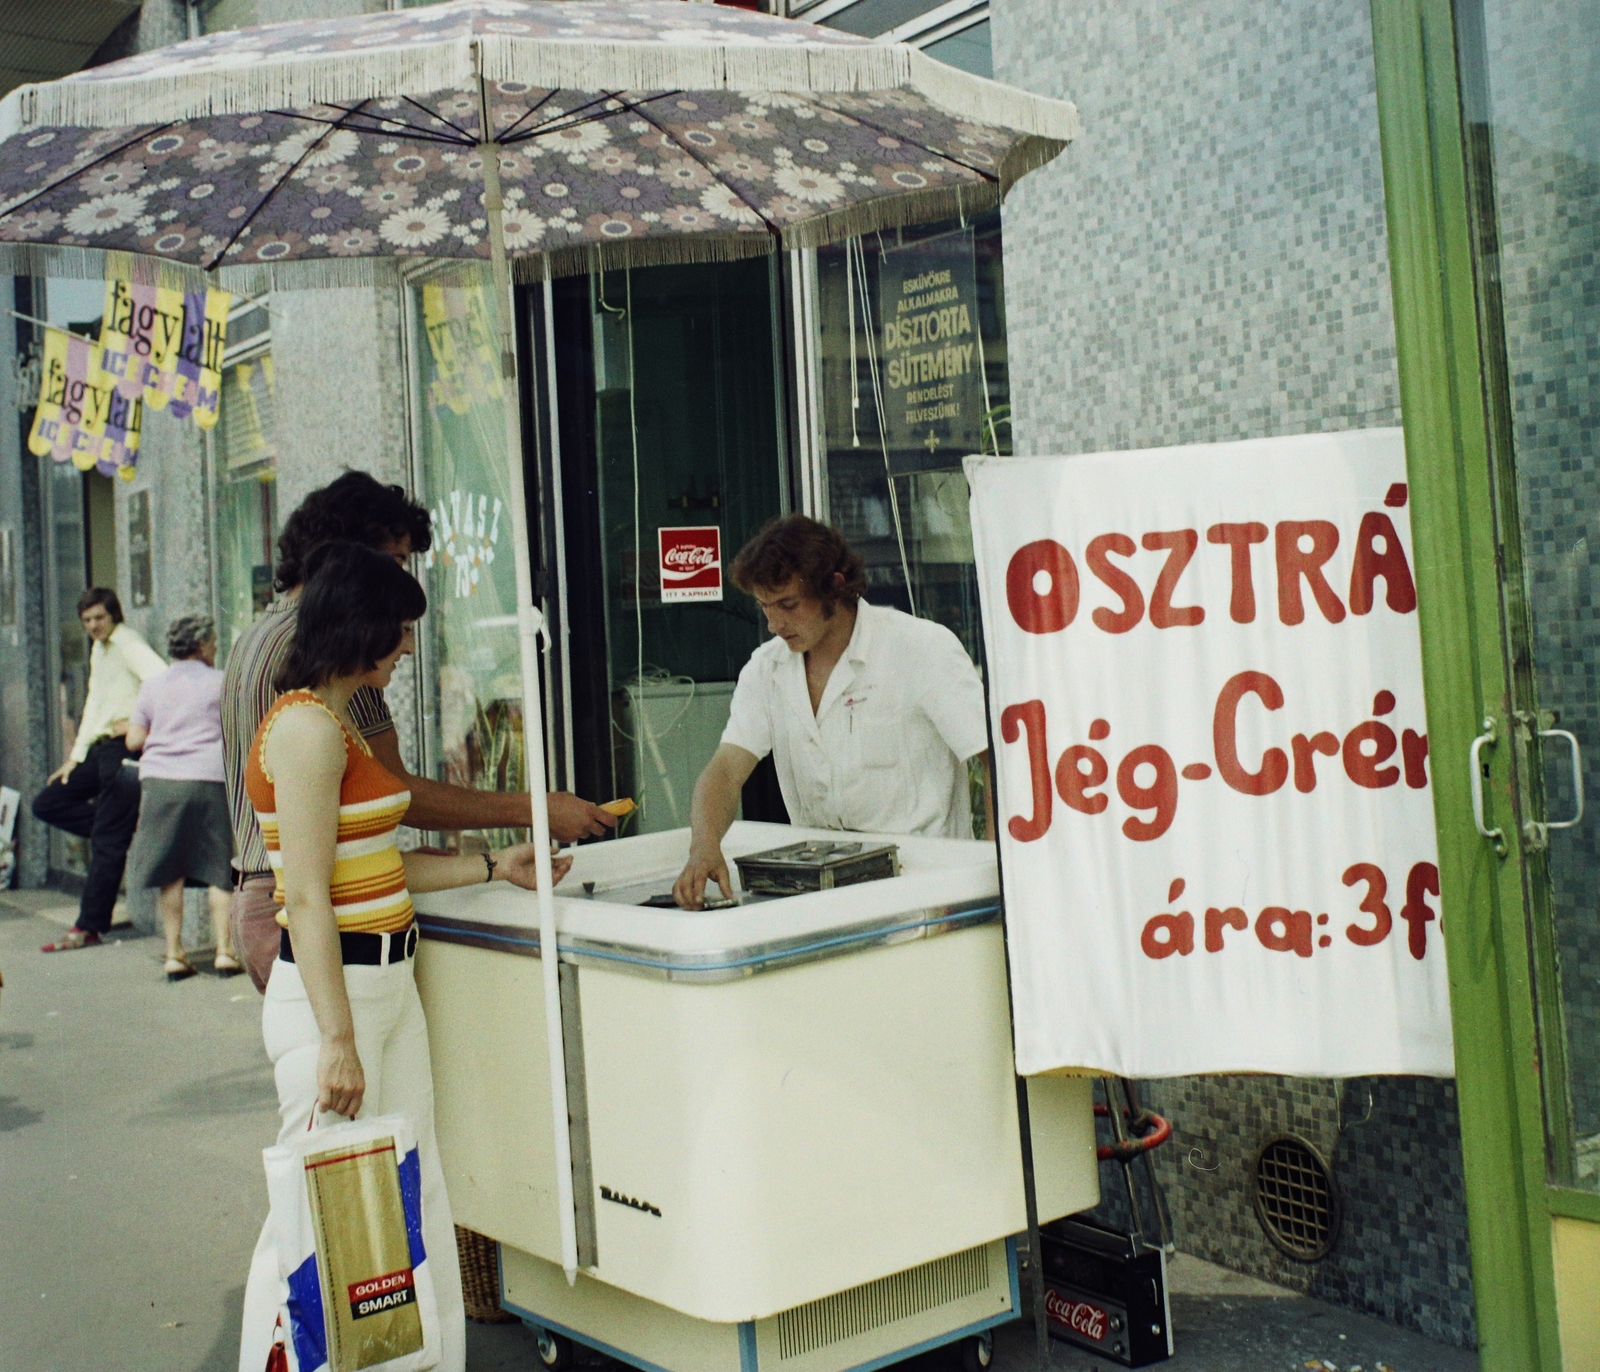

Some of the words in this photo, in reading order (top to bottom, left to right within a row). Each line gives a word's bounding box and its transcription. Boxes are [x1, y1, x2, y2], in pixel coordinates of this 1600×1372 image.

[897, 285, 959, 313] ALKALMAKRA
[107, 280, 226, 374] fagylalt
[884, 303, 972, 350] DÍSZTORTA
[887, 341, 974, 389] SÜTEMÉNY
[665, 547, 715, 566] Coca-Cola
[1006, 483, 1417, 634] OSZTRÁ
[356, 1274, 406, 1296] GOLDEN
[358, 1289, 408, 1315] SMART
[1044, 1289, 1103, 1340] Coca-Cola
